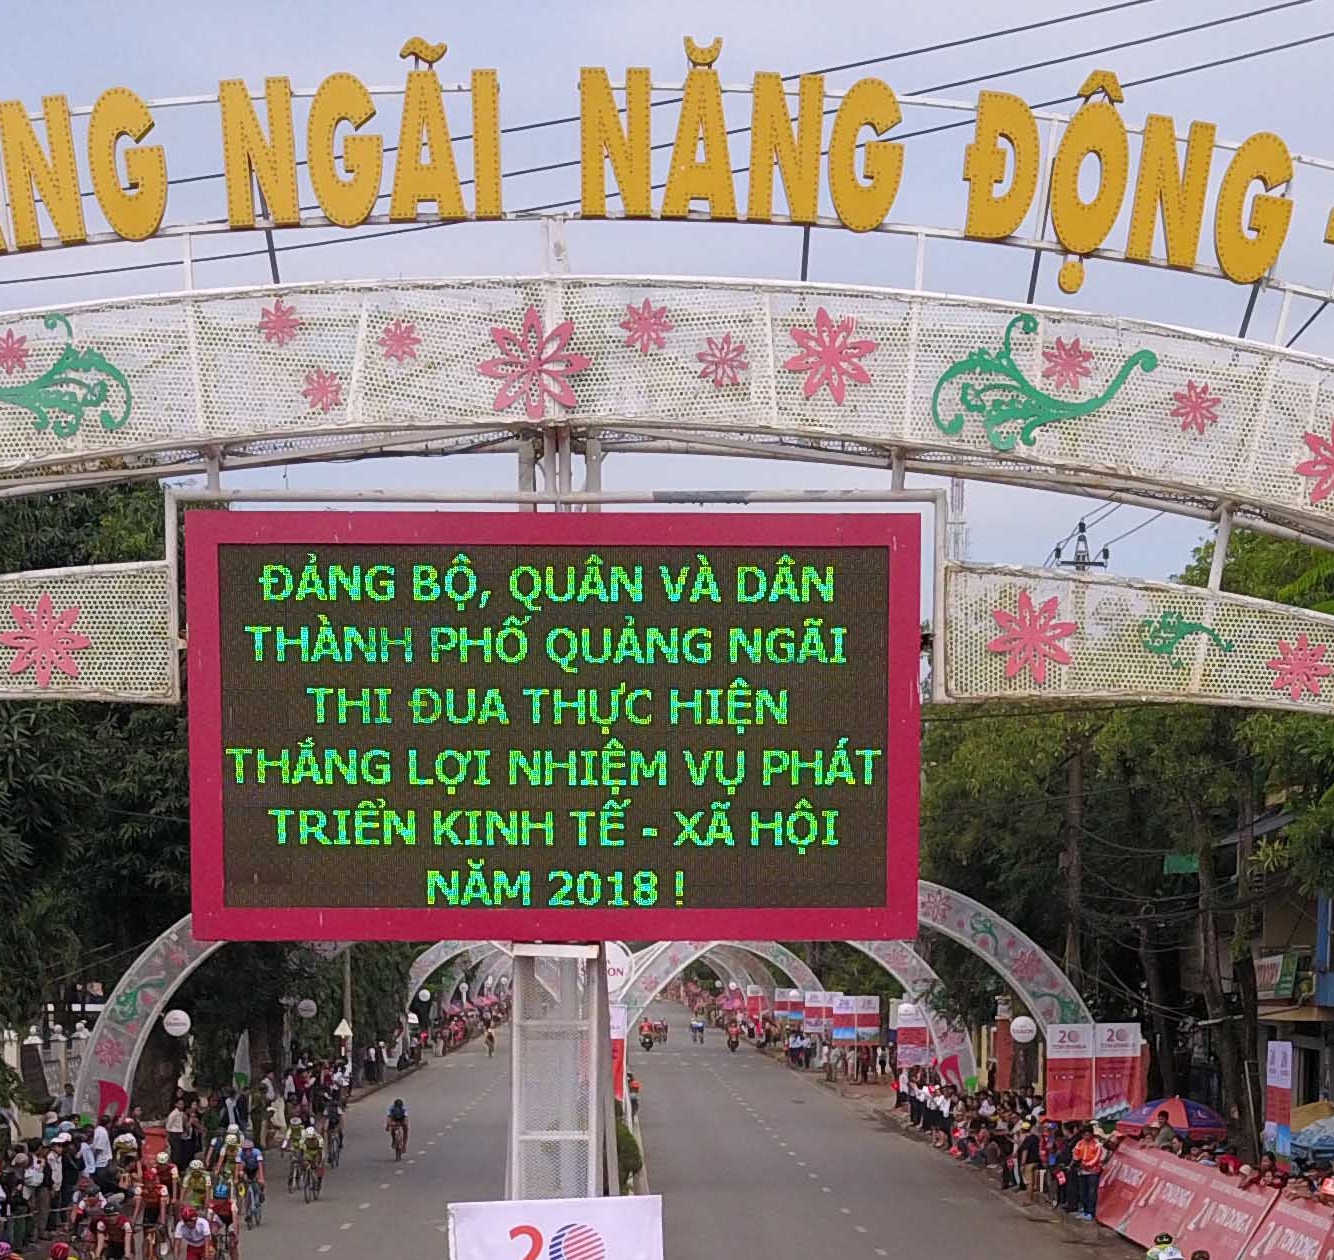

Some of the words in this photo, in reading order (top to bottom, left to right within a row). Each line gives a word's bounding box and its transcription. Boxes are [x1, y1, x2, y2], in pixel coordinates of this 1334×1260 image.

[218, 36, 503, 230] NGÃI
[580, 36, 904, 233] NĂNG
[963, 69, 1293, 294] ĐỘNG
[258, 552, 395, 603] ĐẢNG
[413, 553, 490, 610] BỘ,
[509, 554, 643, 611] QUÂN
[659, 554, 721, 603] VÀ
[736, 554, 836, 603] DÂN
[245, 614, 413, 663] THÀNH
[430, 614, 532, 664] PHỐ
[545, 616, 712, 673] QUẢNG
[728, 618, 847, 664] NGÃI
[306, 687, 391, 725] THI
[408, 687, 509, 725] ĐUA
[523, 682, 652, 734] THỰC
[670, 677, 788, 734] HIỆN
[225, 737, 391, 785] THẮNG
[408, 748, 490, 795] LỢI
[508, 738, 668, 795] NHIỆM
[683, 749, 745, 796] VỤ
[762, 738, 881, 786] PHÁT
[268, 797, 416, 846] TRIỂN
[432, 809, 554, 847] KINH
[569, 799, 632, 847] TẾ
[674, 803, 736, 847] XÃ
[750, 798, 839, 855] HỘI
[427, 859, 532, 906] NĂM
[548, 870, 658, 907] 2018
